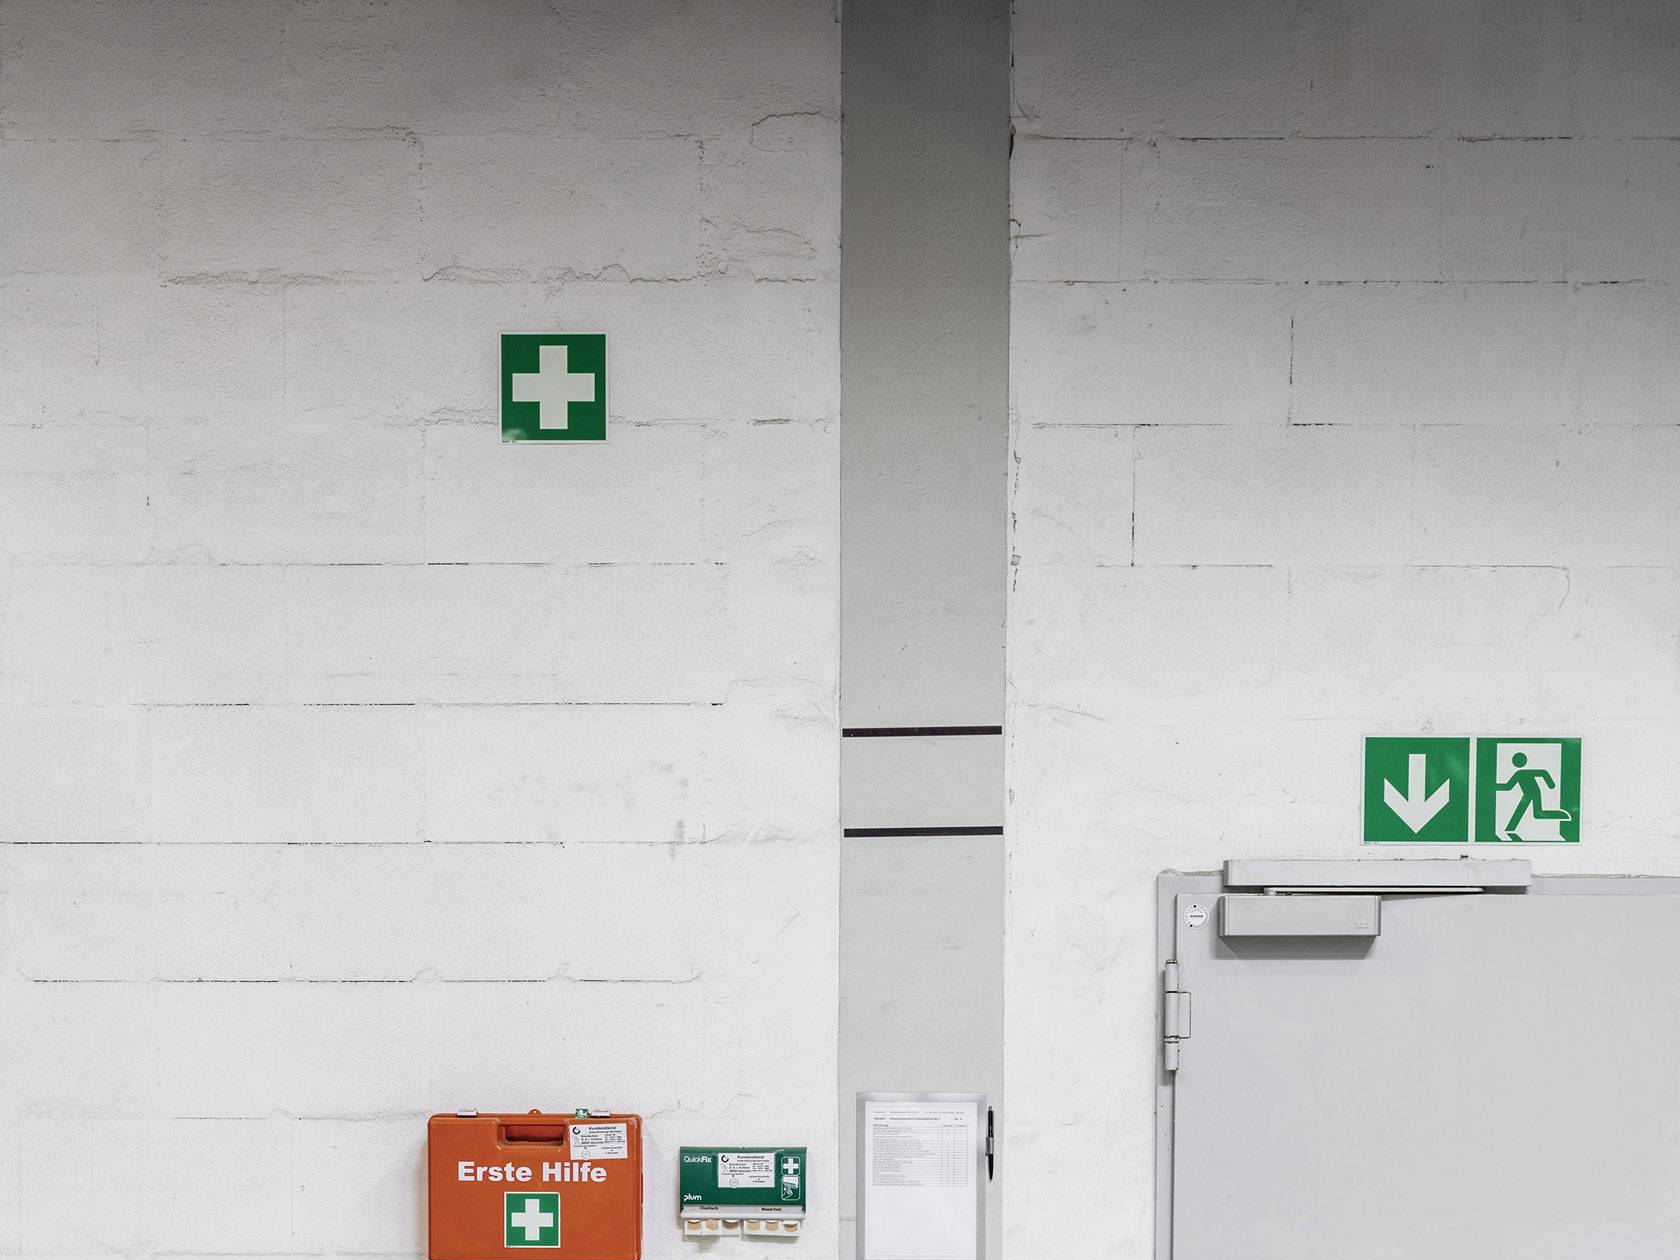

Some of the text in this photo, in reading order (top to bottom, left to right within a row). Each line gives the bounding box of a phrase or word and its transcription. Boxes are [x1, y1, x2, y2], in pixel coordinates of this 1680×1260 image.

[683, 1155, 712, 1163] QuickFix
[457, 1161, 607, 1182] Erste Hilfe
[683, 1193, 702, 1202] plum
